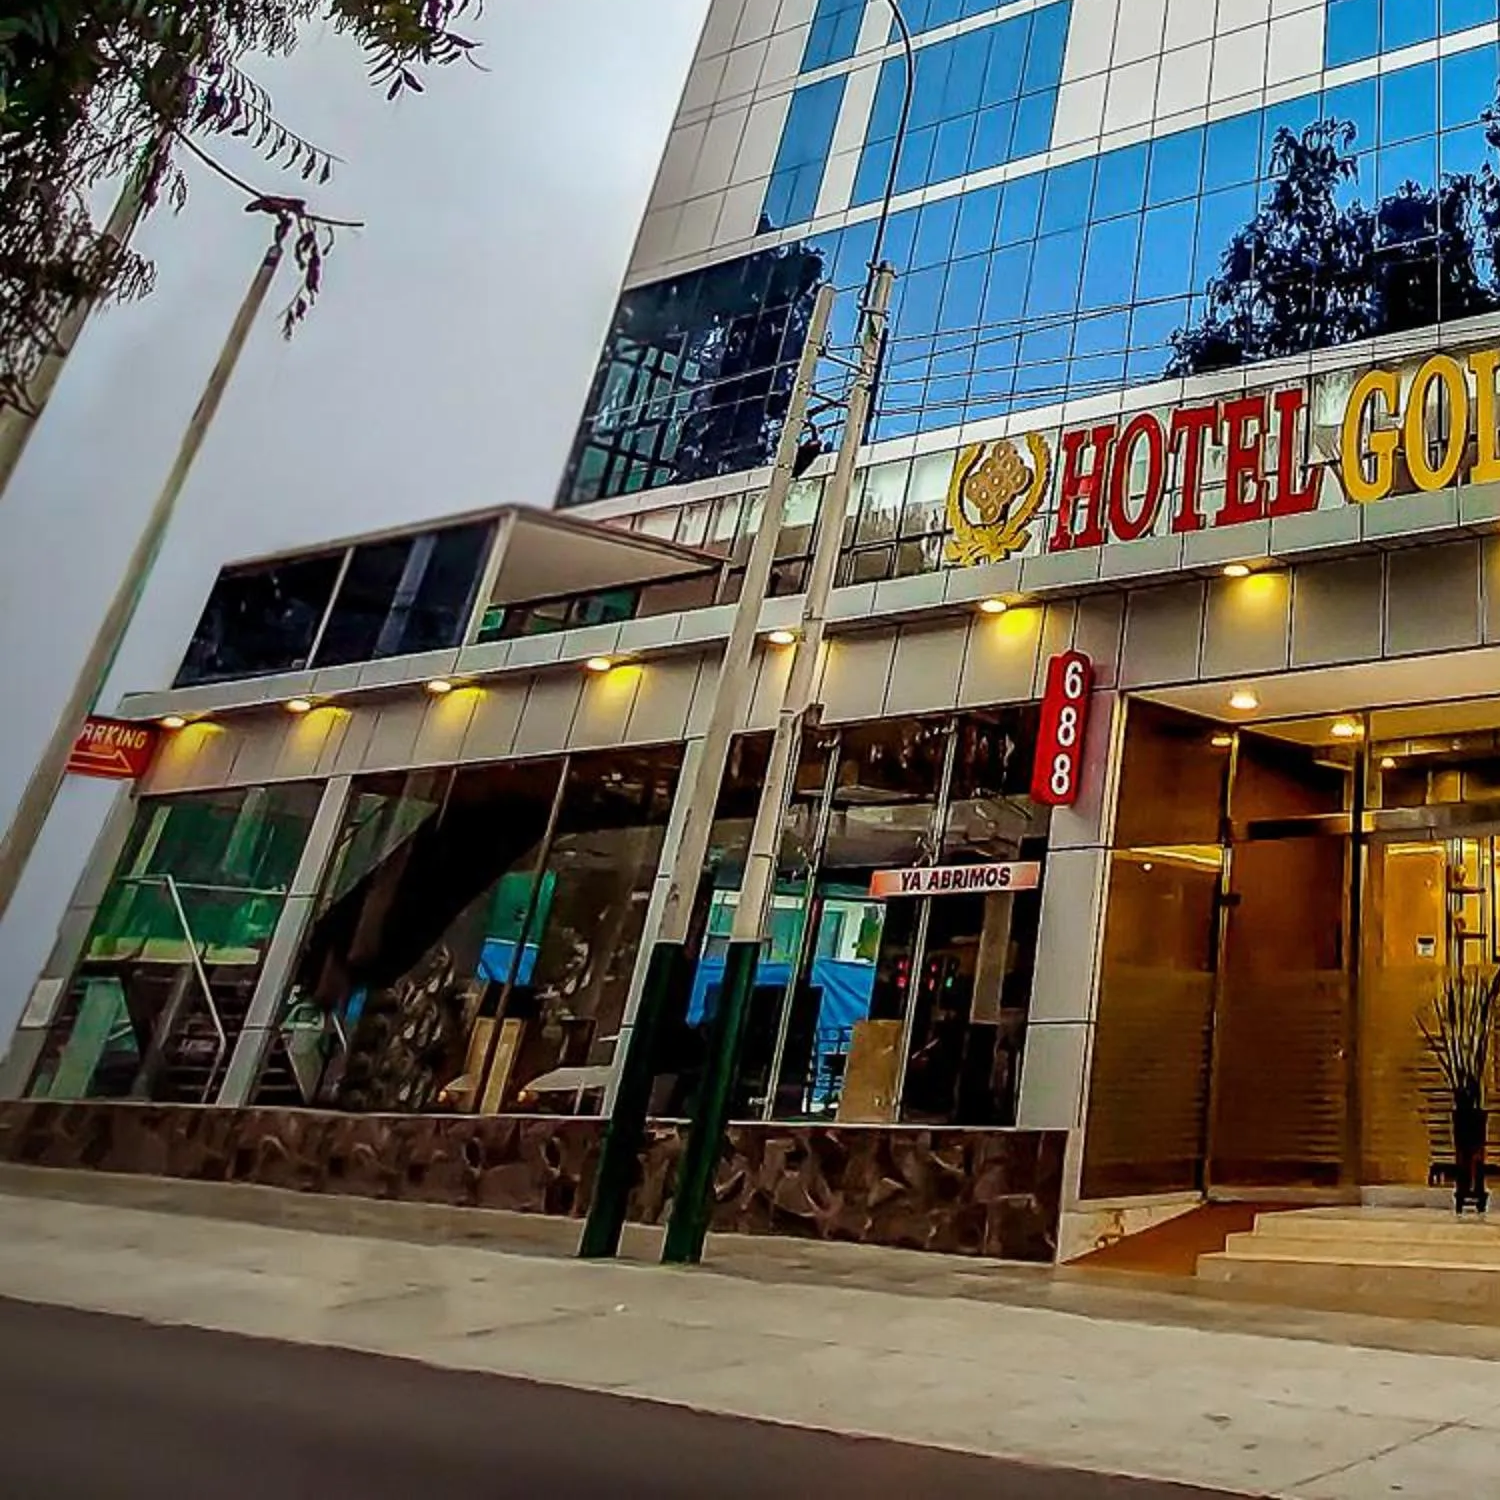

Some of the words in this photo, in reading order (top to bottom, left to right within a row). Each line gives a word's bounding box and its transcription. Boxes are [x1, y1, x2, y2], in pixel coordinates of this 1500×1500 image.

[1048, 389, 1324, 553] HOTEL
[82, 723, 148, 749] ARKING
[1050, 660, 1084, 796] 688
[901, 870, 922, 892] YA
[928, 866, 1011, 890] ABRIMOS
